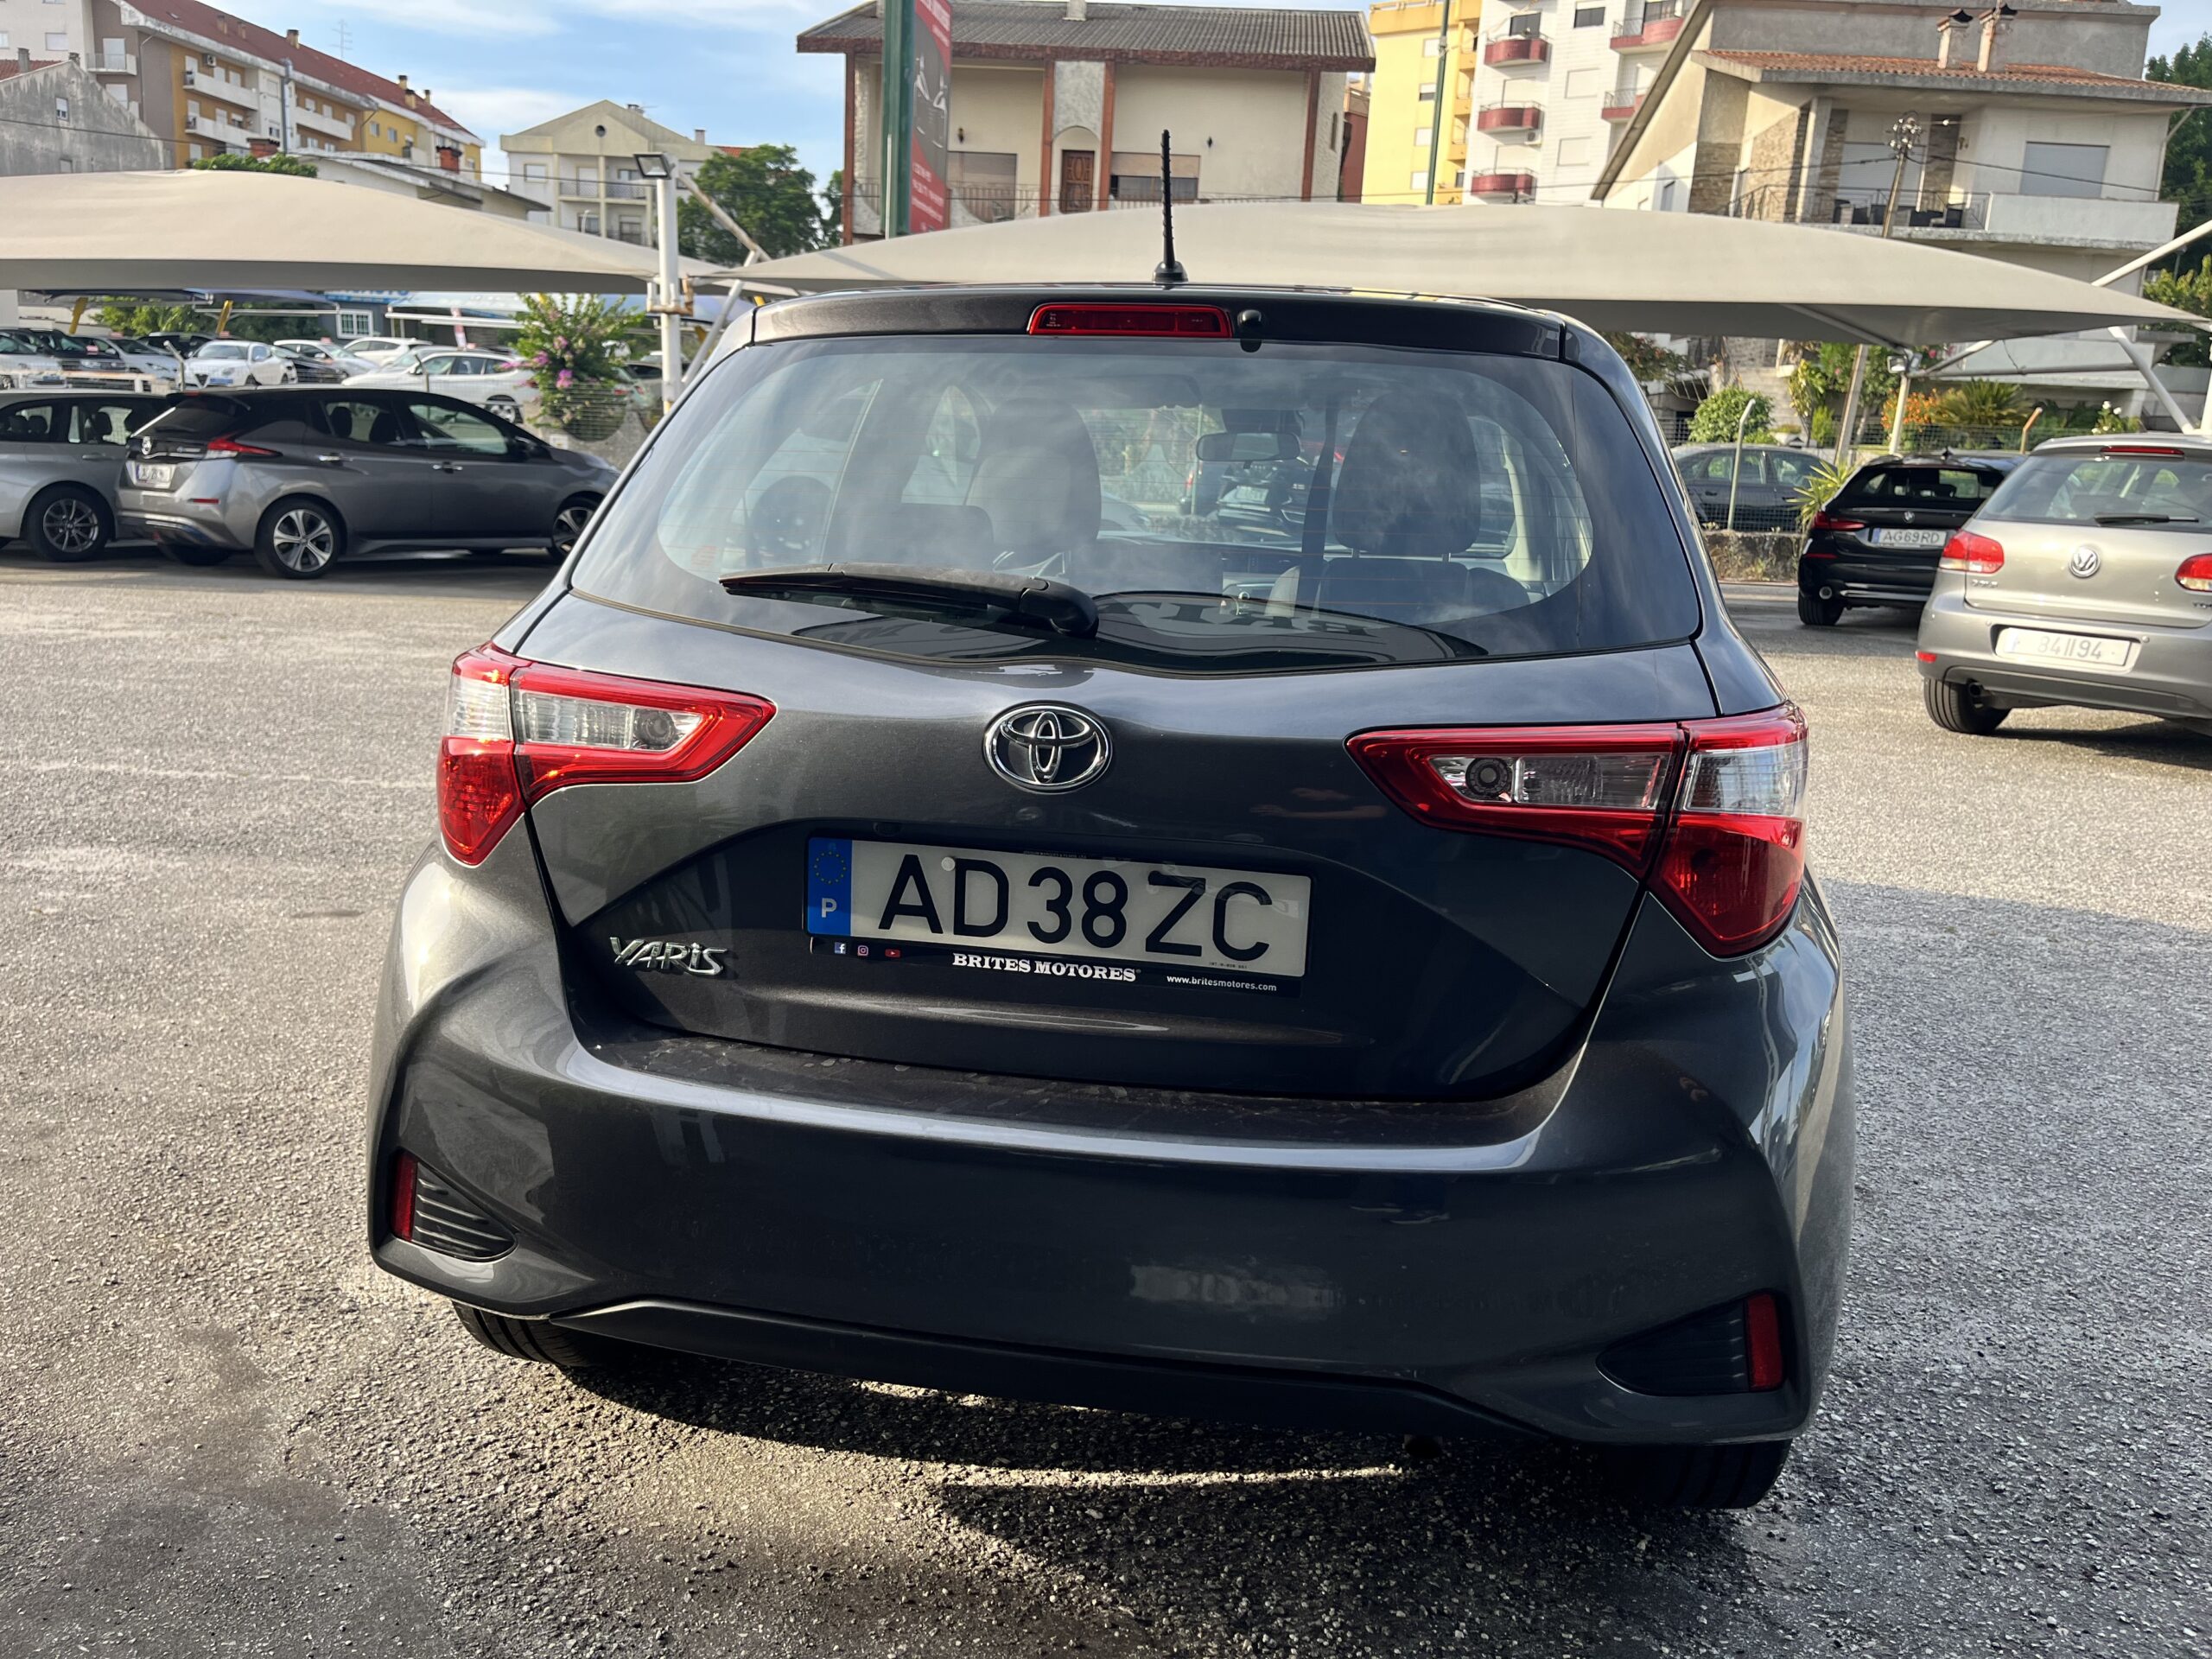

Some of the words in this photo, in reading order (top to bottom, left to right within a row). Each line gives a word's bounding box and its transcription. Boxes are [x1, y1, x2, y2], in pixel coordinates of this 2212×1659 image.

[821, 897, 837, 918] P
[952, 952, 1031, 973] BRITES
[1033, 960, 1136, 982] MOTORES
[1166, 975, 1277, 992] www.britesmotores.com
